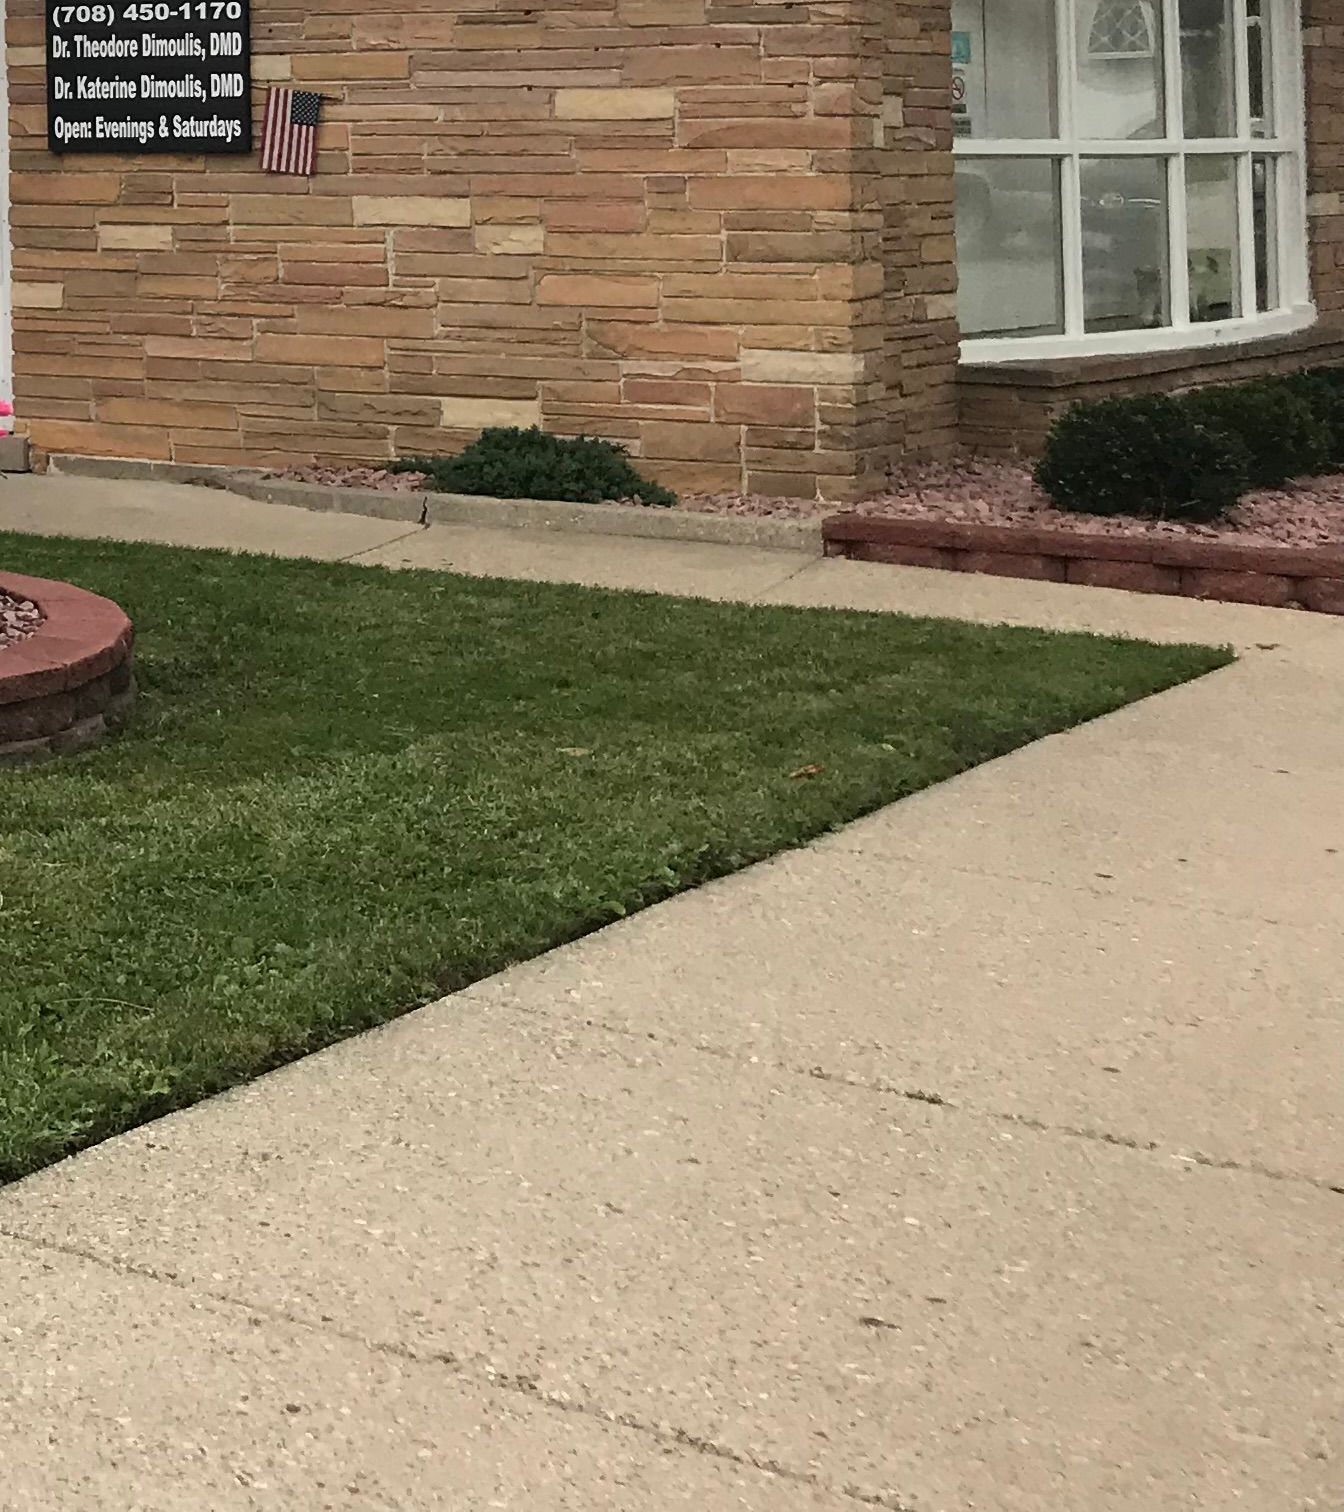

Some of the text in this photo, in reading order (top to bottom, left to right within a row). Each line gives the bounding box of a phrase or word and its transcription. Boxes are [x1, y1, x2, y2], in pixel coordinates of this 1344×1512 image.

[52, 2, 242, 27] (708) 450-1170
[52, 32, 242, 61] Dr. Theodore Dimoulis, DMD
[54, 73, 244, 103] Dr. Katerine Dimoulis, DMD
[54, 114, 242, 144] Open: Evenings & Saturdays
